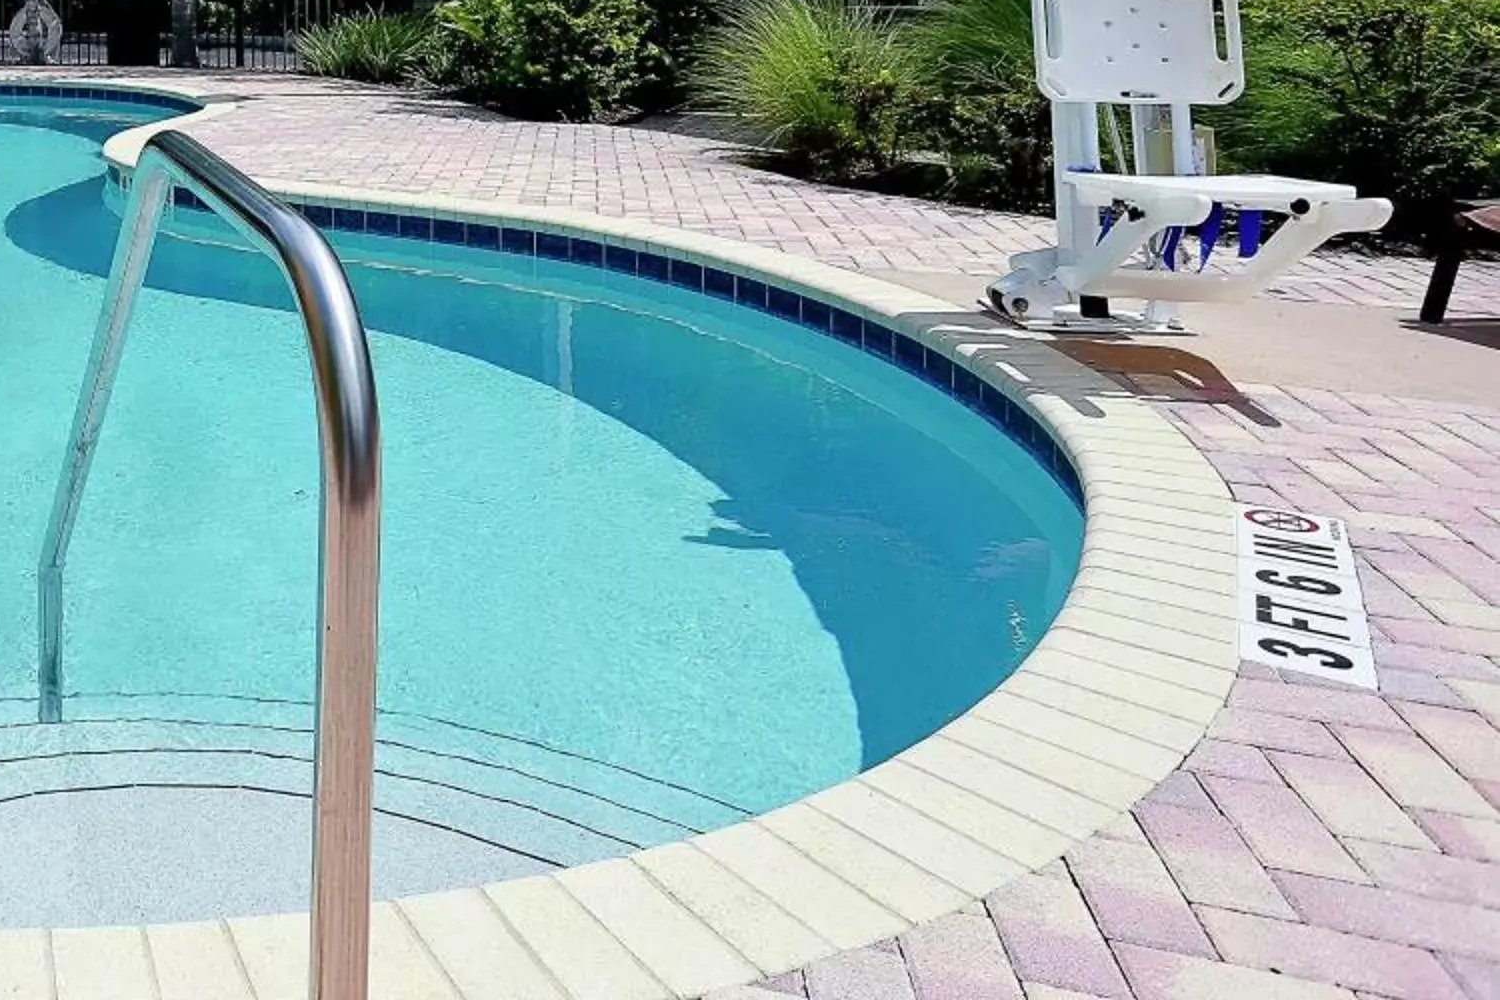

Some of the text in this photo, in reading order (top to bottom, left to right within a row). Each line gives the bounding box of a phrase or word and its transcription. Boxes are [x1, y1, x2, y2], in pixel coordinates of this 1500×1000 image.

[1253, 533, 1354, 671] 3 FT 6 IN
